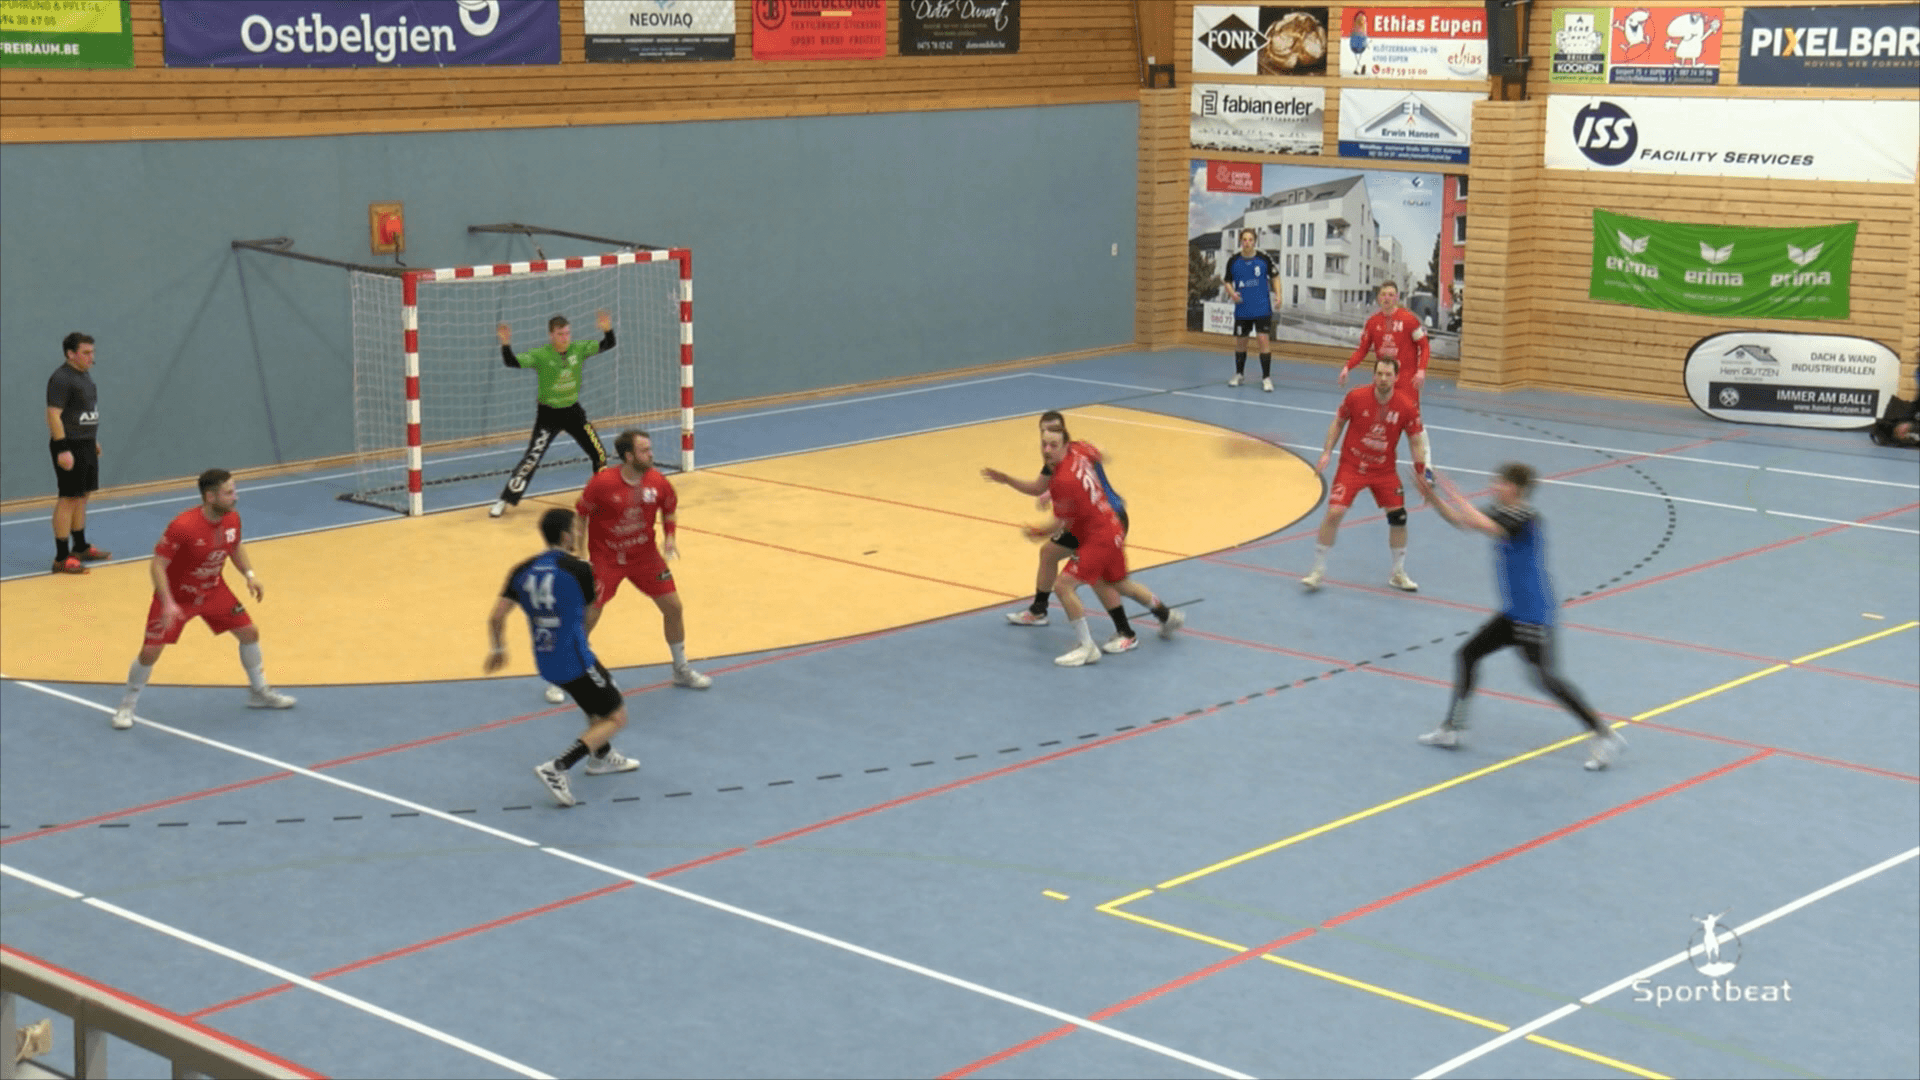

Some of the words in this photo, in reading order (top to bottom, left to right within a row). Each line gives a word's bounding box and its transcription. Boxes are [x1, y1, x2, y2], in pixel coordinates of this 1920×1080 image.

[629, 13, 693, 28] NEOVIAQ
[1374, 15, 1426, 33] Ethias
[1430, 15, 1482, 37] Eupen
[241, 13, 456, 63] Ostbelgien
[1207, 30, 1258, 50] FONK
[1750, 26, 1919, 57] PIXELBAR
[1557, 63, 1600, 73] KOONEN
[1222, 94, 1272, 114] fabian
[1274, 97, 1313, 116] erler
[1381, 128, 1406, 138] Erwin
[1408, 130, 1440, 139] Hansen
[1577, 110, 1635, 149] ISS
[1640, 149, 1718, 163] FACILITY
[1723, 151, 1814, 167] SERVICES
[1606, 255, 1659, 279] erima
[1684, 267, 1744, 286] erima
[1770, 270, 1831, 287] erima
[1810, 352, 1836, 362] DACH
[1839, 353, 1846, 363] &
[1847, 353, 1876, 364] WAND
[1791, 363, 1876, 376] INDUSTRIEHALLEN
[1776, 389, 1815, 403] IMMER
[1818, 391, 1836, 403] AM
[1838, 392, 1872, 405] BALL!
[522, 573, 557, 610] 14
